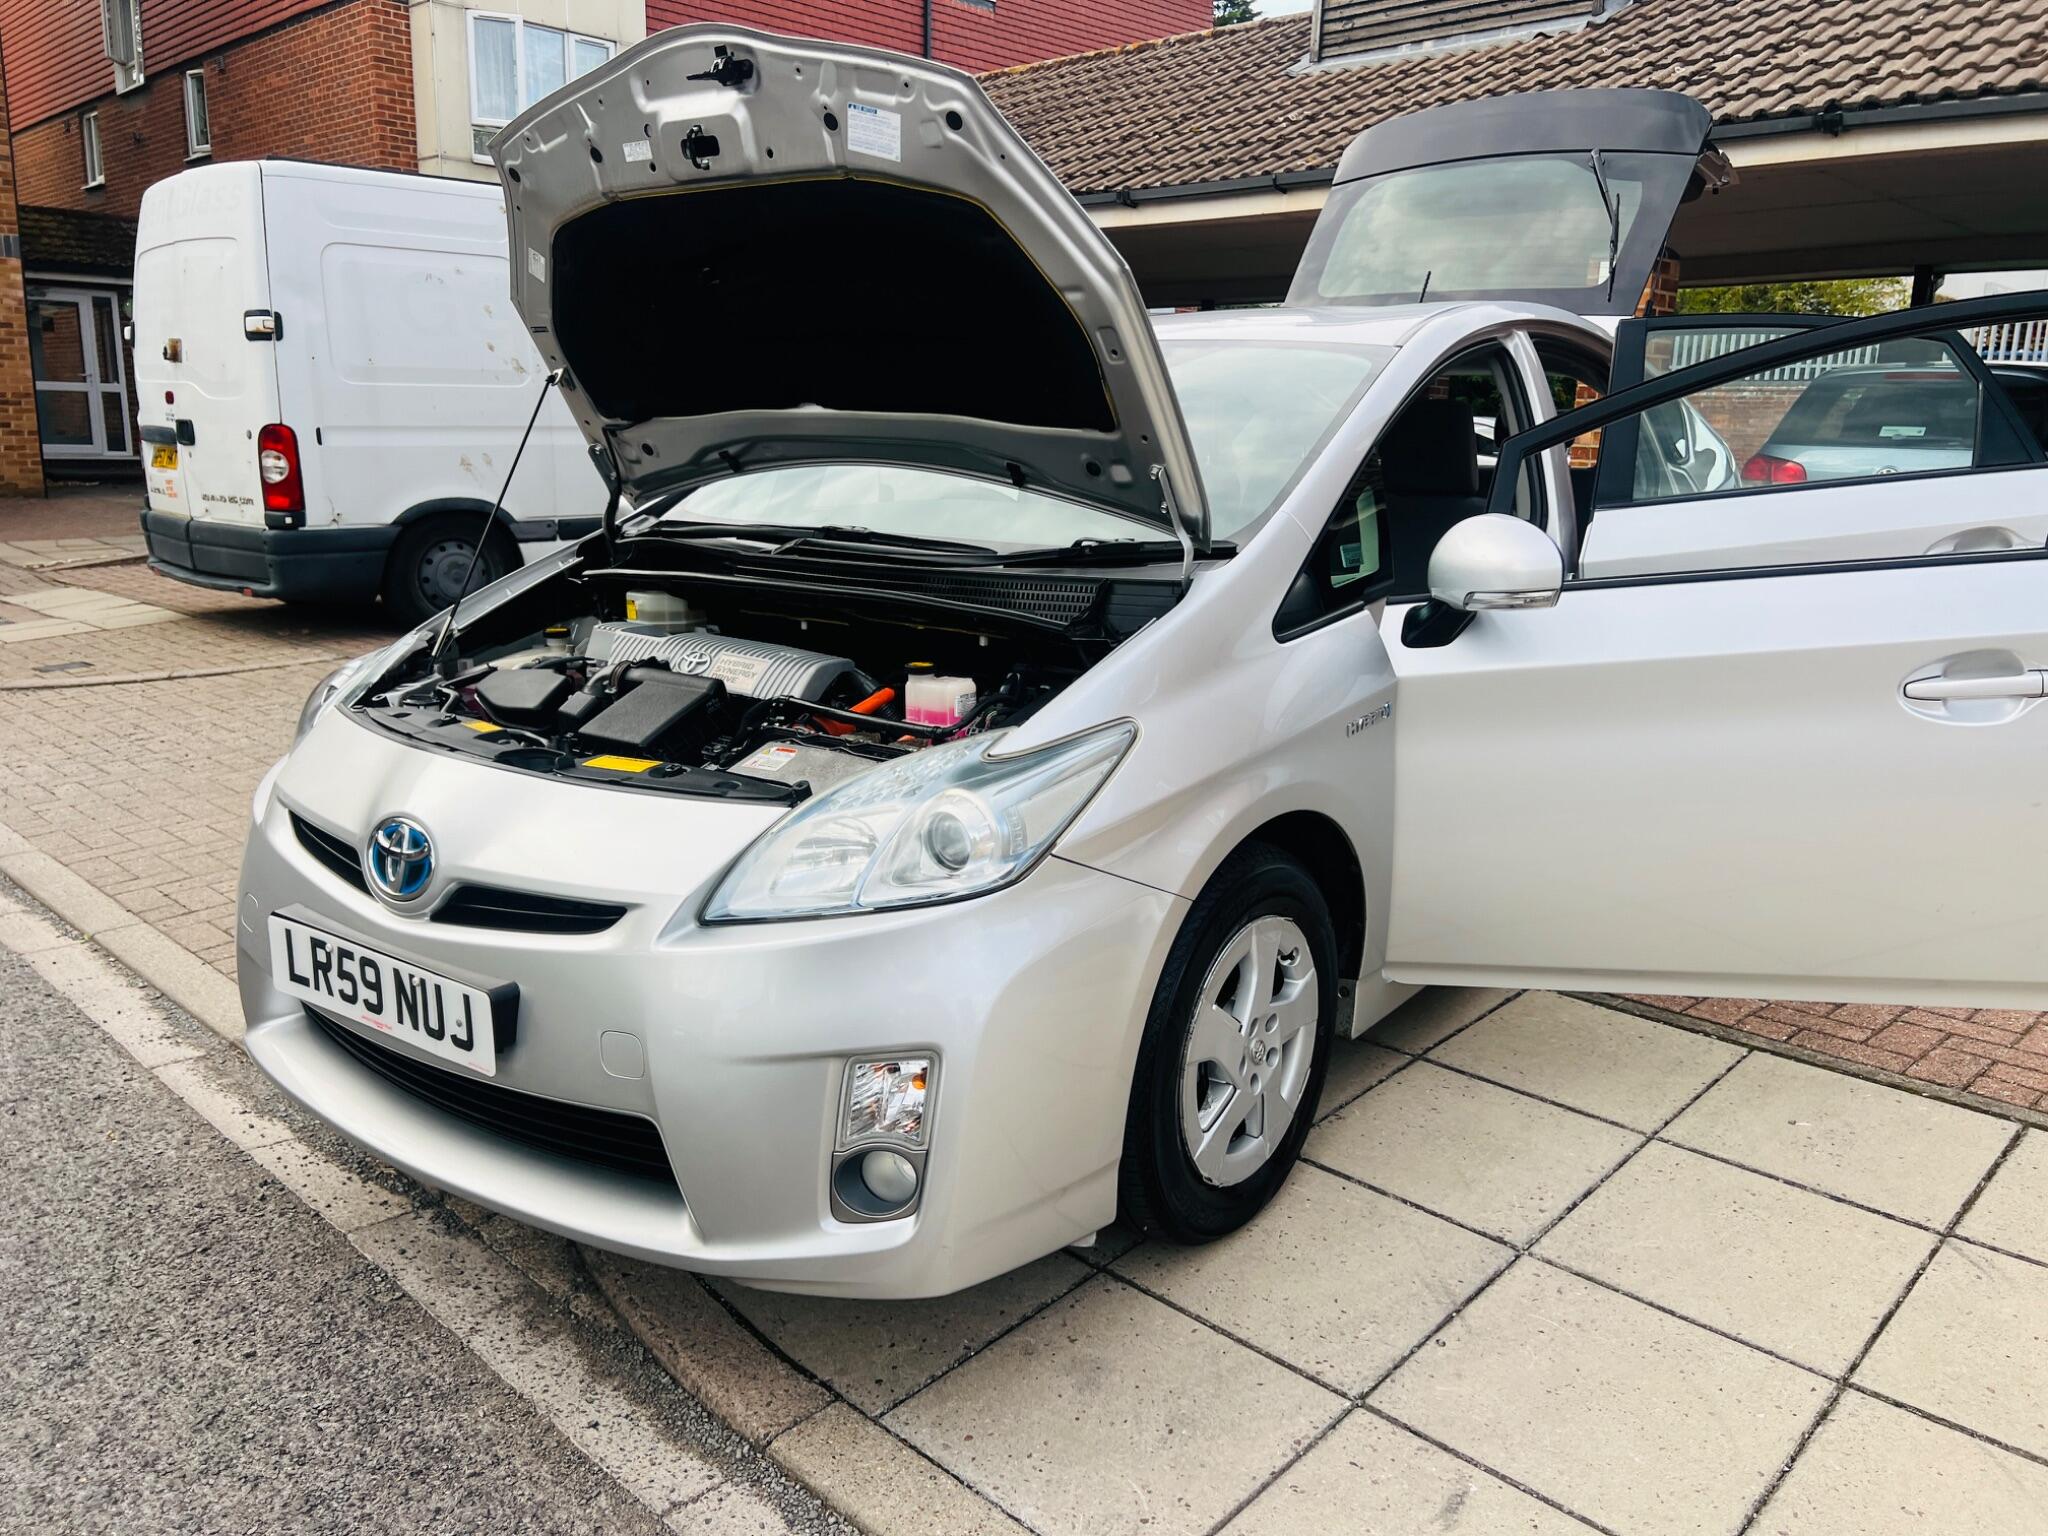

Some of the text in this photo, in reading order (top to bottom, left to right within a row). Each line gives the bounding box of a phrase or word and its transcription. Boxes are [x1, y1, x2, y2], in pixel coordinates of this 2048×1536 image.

[720, 659, 755, 671] HYBRID
[711, 672, 737, 683] DRIVE
[715, 665, 757, 679] SYNERGY
[285, 928, 474, 1052] LR59 NUJ
